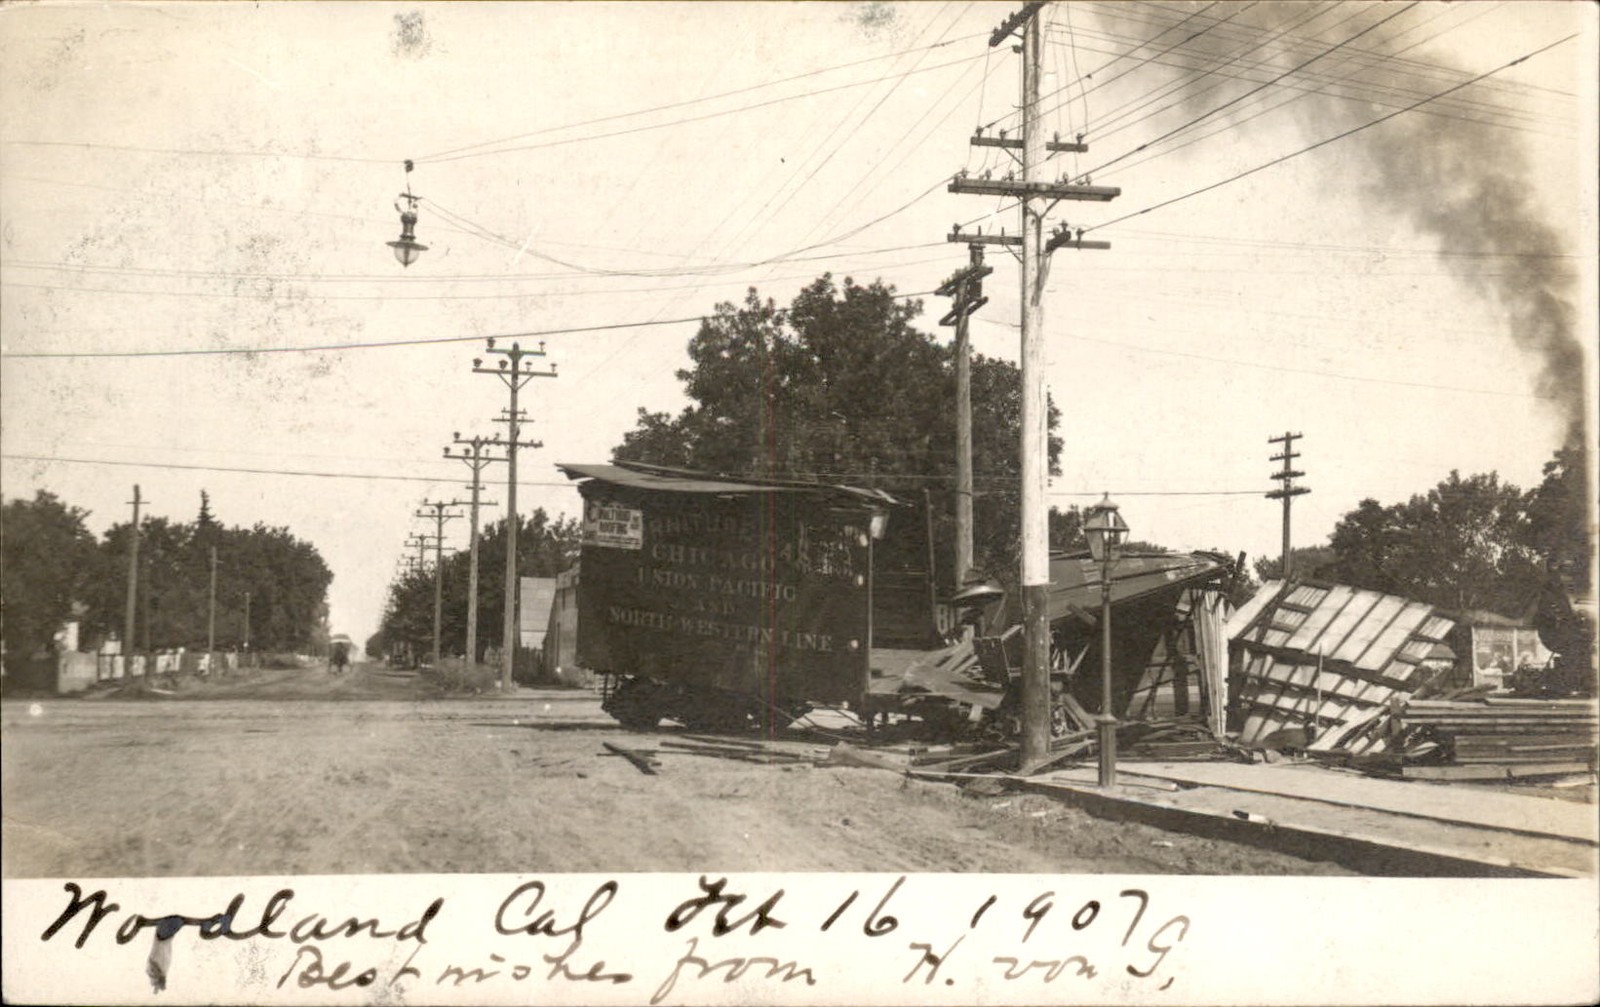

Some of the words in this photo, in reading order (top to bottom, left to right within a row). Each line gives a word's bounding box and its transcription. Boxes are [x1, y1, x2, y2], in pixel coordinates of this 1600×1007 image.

[651, 543, 776, 571] CHICAGO
[709, 575, 797, 602] PACIFIC
[781, 629, 834, 652] LINE
[41, 882, 444, 946] Woodland
[495, 881, 617, 944] Cal
[821, 876, 905, 937] 16
[971, 889, 1149, 945] 1907
[277, 944, 421, 990] Best
[437, 942, 632, 987] wishes
[650, 938, 816, 1005] from
